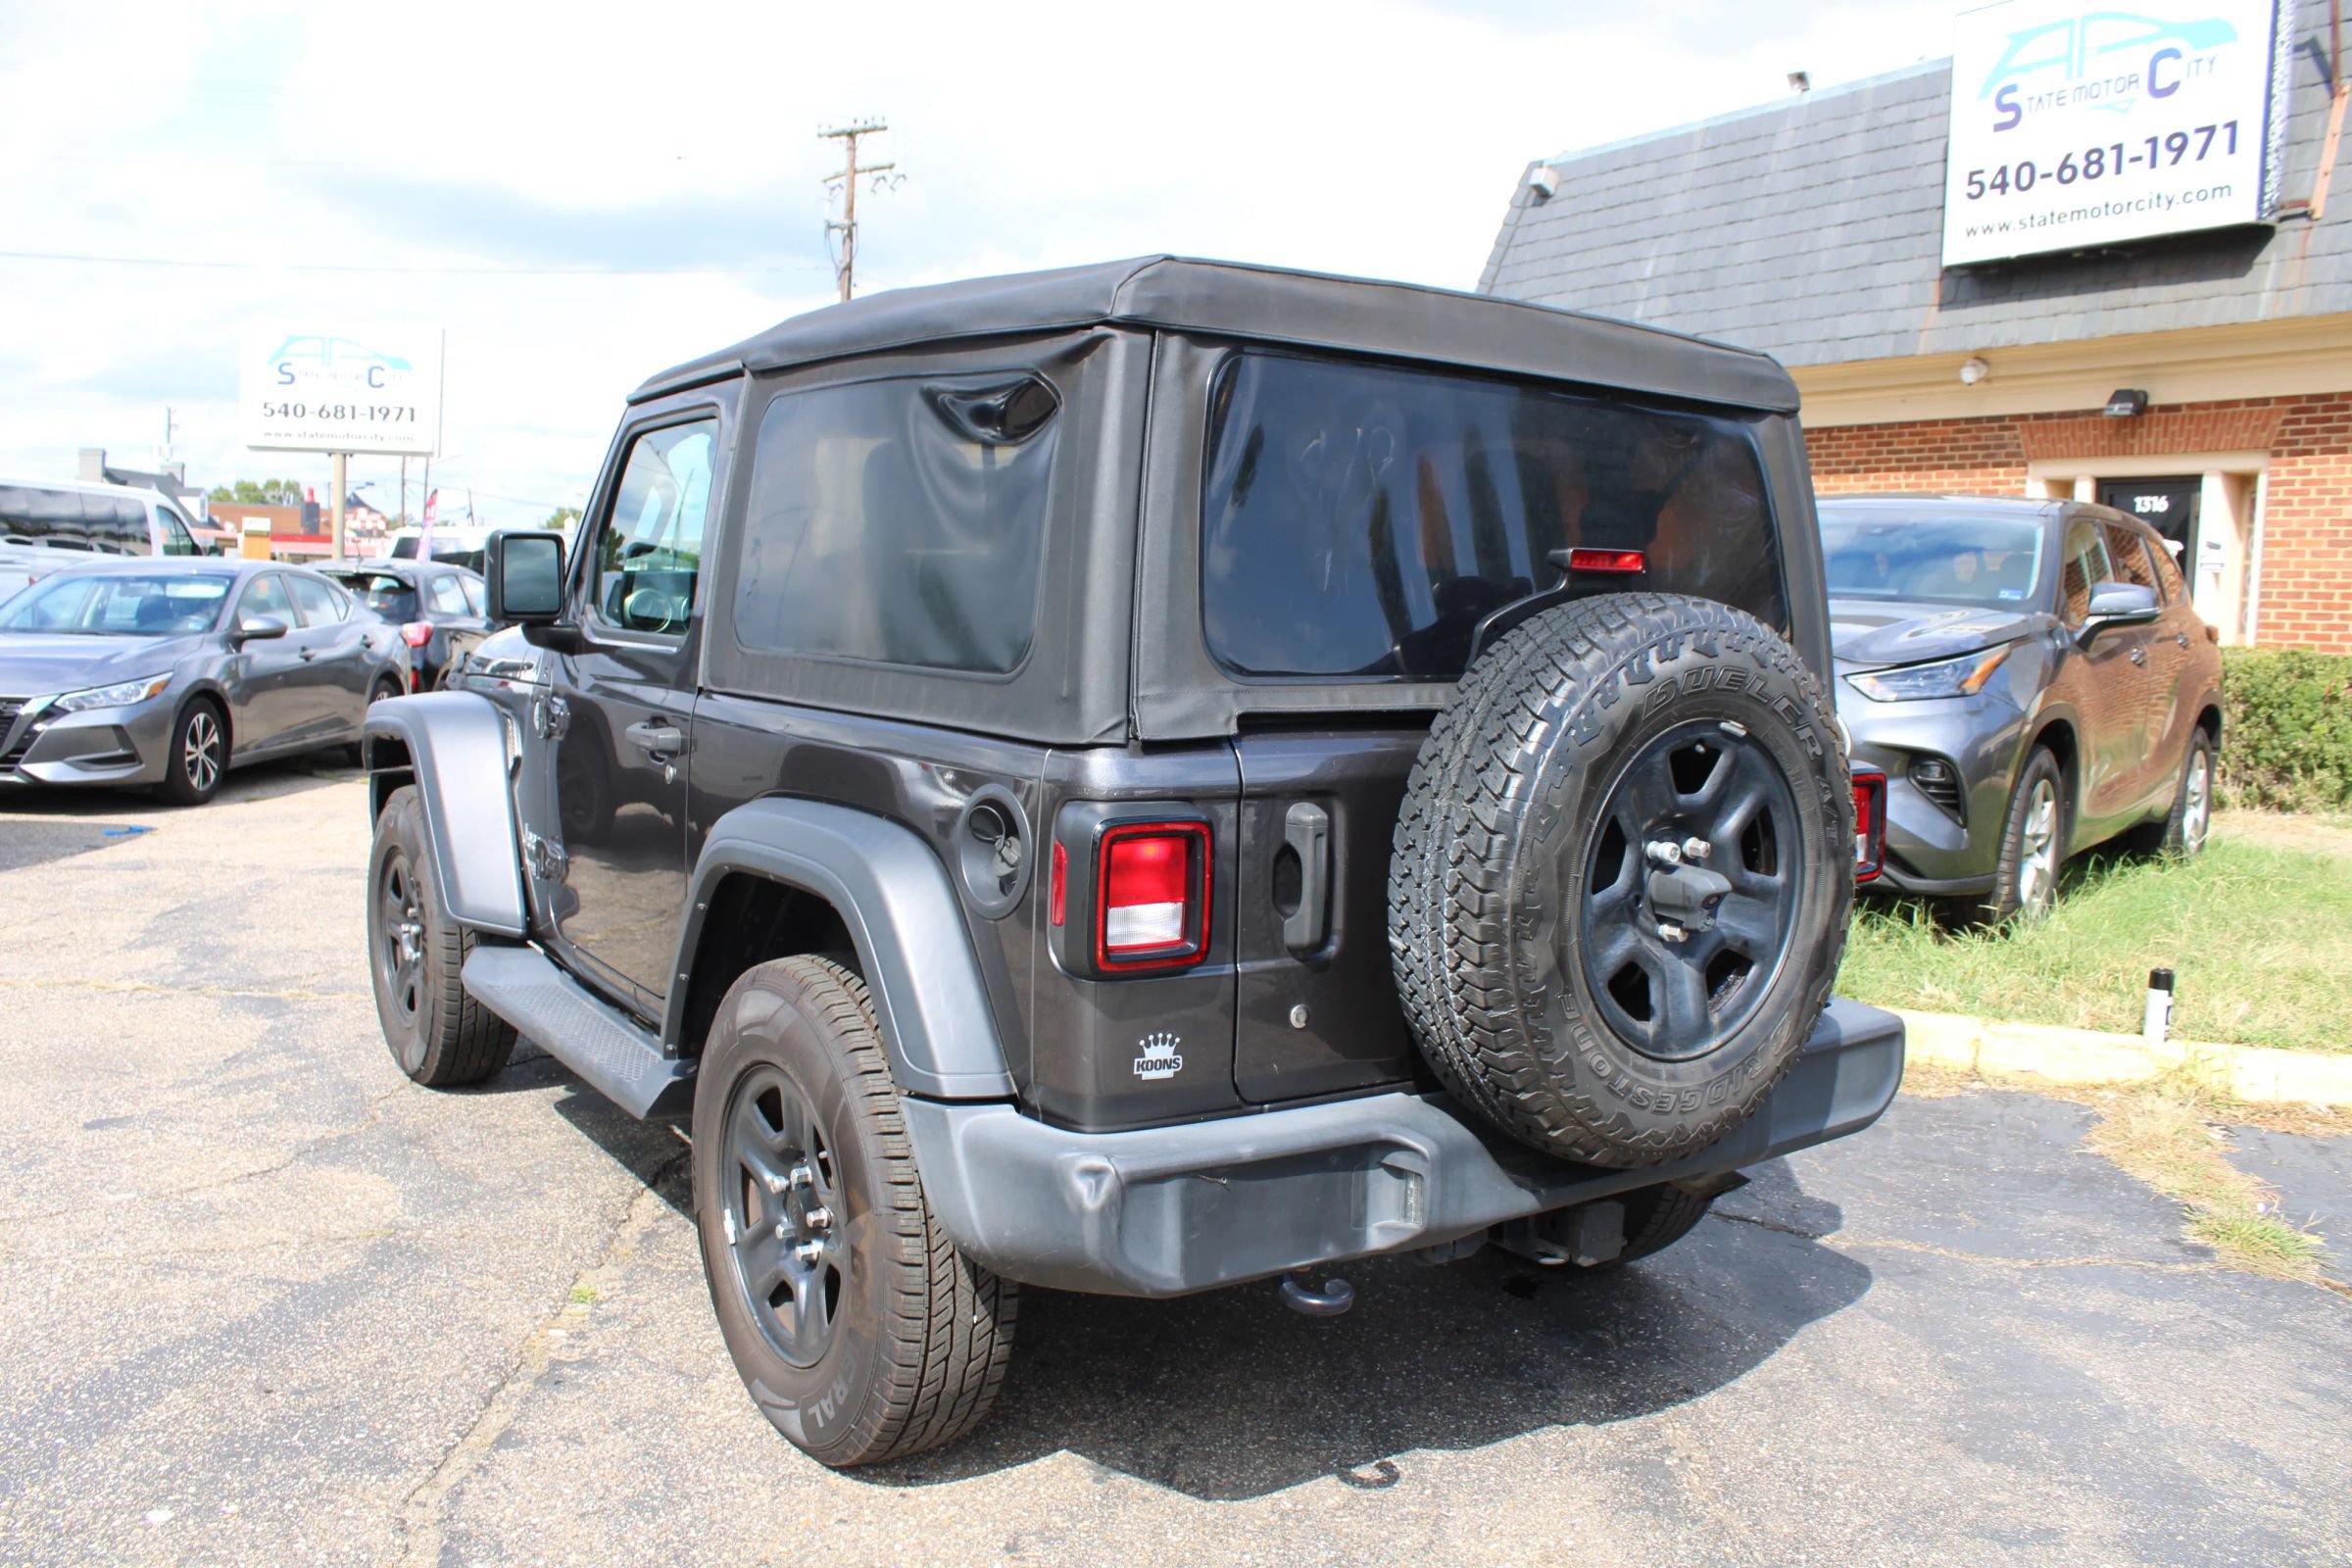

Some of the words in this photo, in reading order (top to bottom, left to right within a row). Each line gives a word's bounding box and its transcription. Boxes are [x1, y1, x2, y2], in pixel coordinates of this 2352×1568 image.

[2073, 74, 2140, 108] MOTOR
[2147, 47, 2218, 99] CITY
[1966, 120, 2239, 201] 540-681-1971
[1965, 183, 2232, 238] www.statemotorcity.com
[263, 402, 416, 422] 540-681-1971
[1642, 664, 1824, 761] DUELER
[1136, 1057, 1181, 1073] KOONS
[1556, 992, 1791, 1115] BRIDGESTONE
